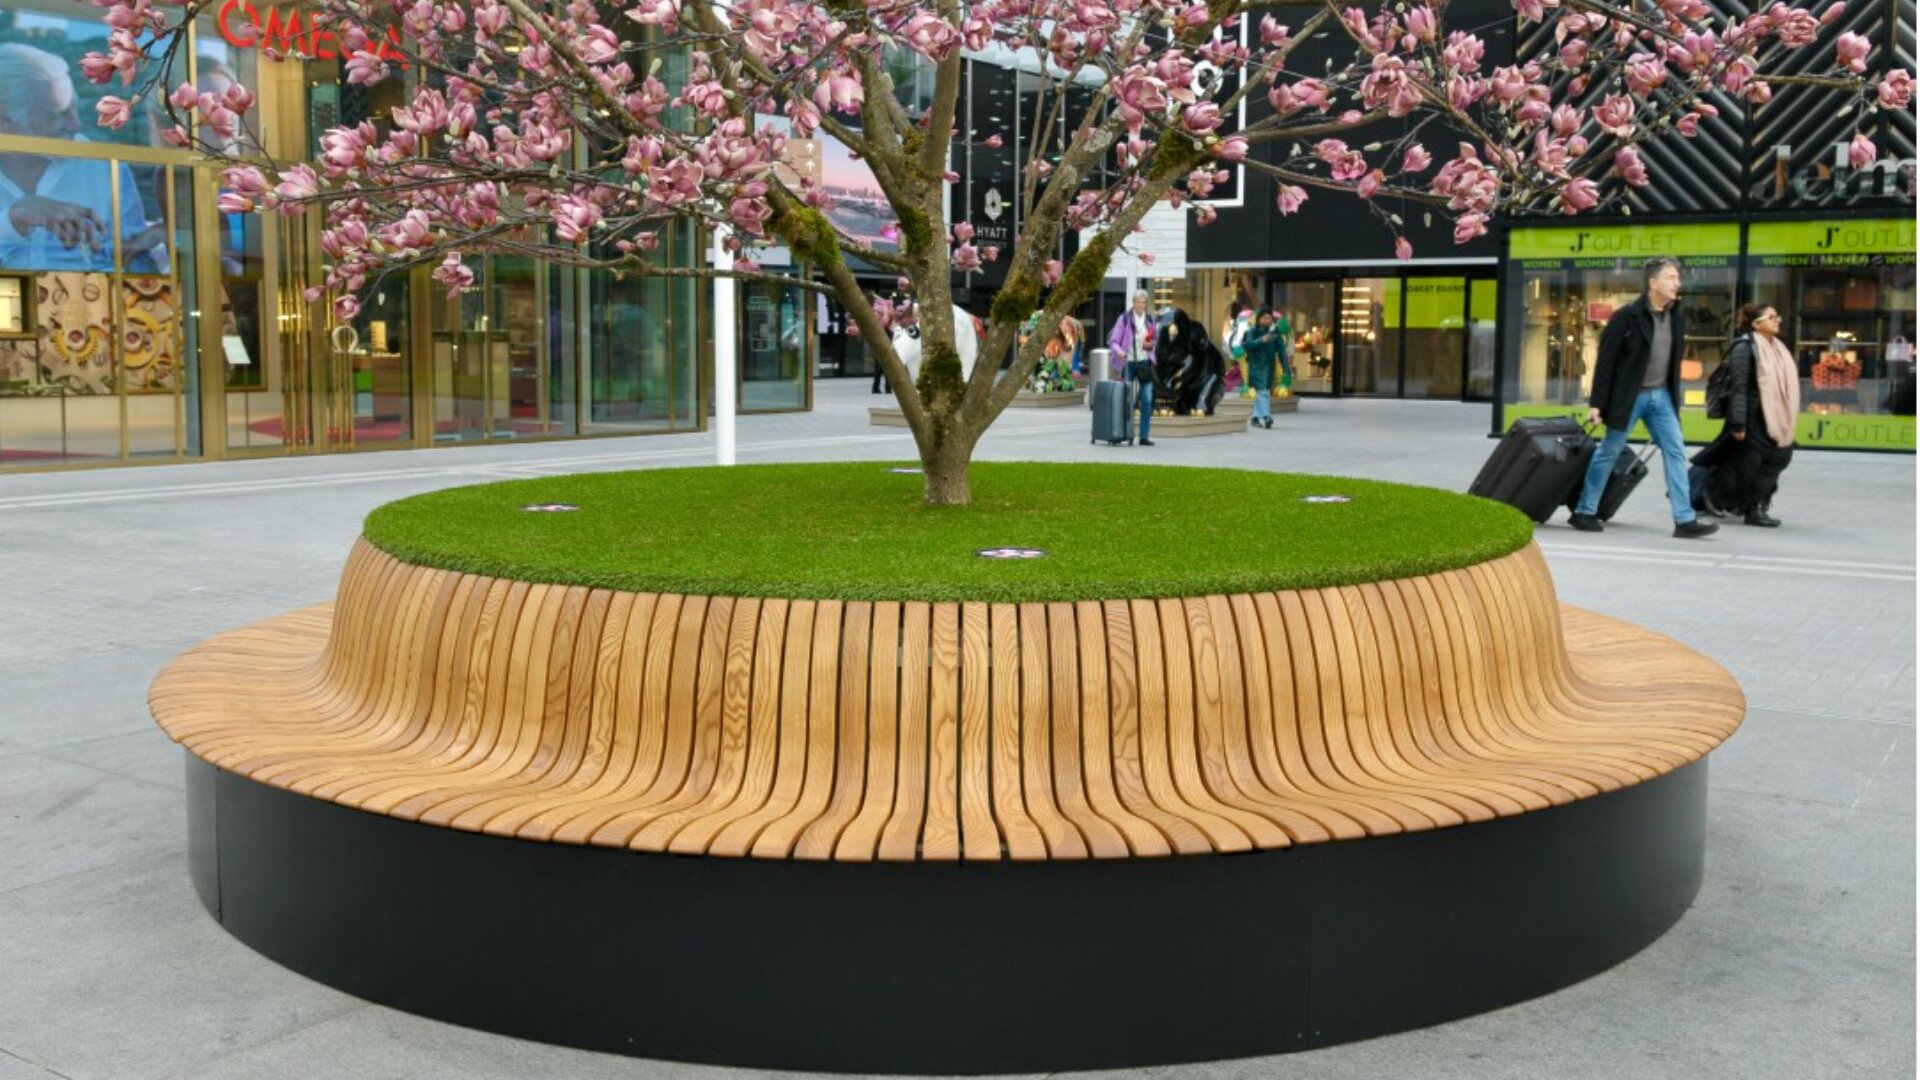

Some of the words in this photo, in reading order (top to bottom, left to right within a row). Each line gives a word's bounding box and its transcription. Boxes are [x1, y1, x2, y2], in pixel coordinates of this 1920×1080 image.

[977, 225, 1008, 239] HYATT
[1843, 228, 1916, 249] OUTL
[1593, 232, 1677, 251] OUTLET
[1522, 259, 1562, 269] WOMEN
[1574, 258, 1615, 269] WOMEN
[1684, 257, 1728, 268] WOMEN
[1762, 255, 1809, 266] WOMEN
